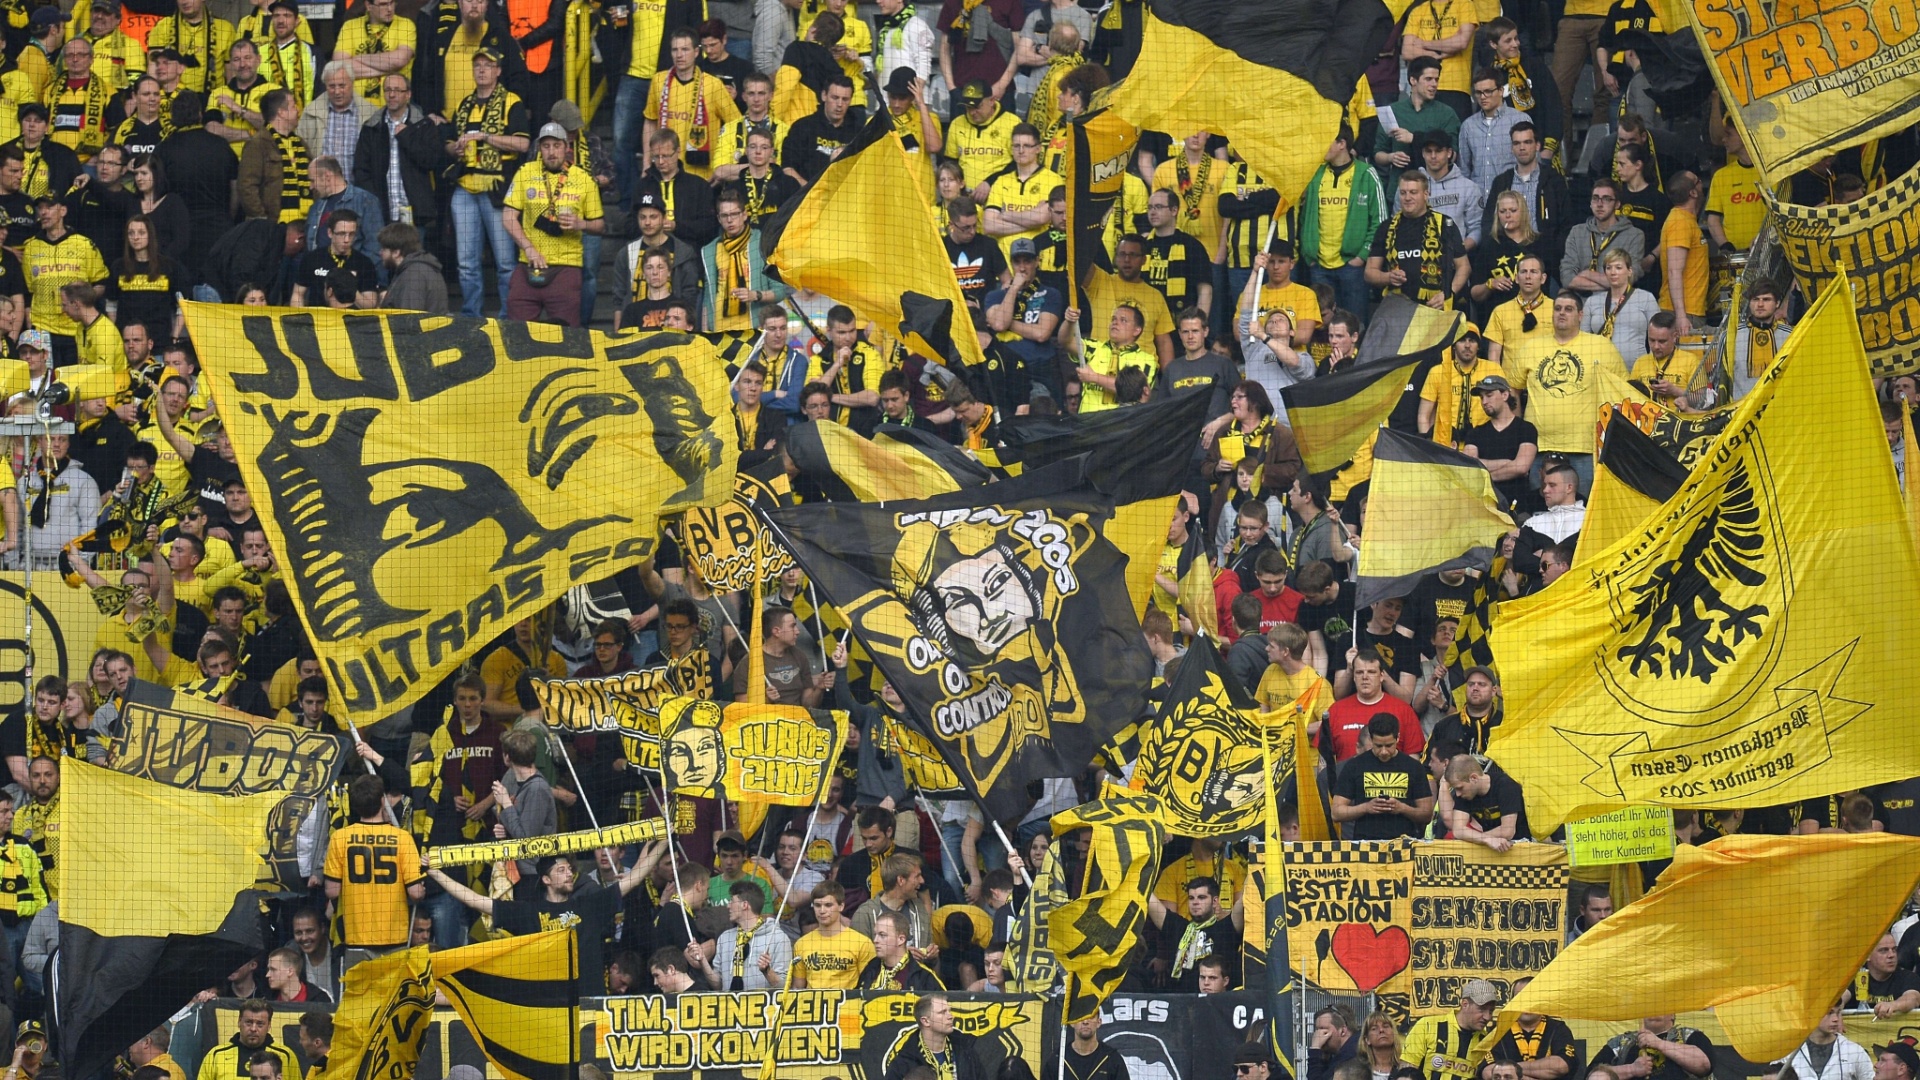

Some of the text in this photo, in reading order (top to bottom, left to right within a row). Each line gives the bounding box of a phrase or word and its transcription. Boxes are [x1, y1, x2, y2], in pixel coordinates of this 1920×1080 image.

[1714, 0, 1920, 107] VERBO
[1786, 80, 1818, 104] IHR
[1818, 60, 1869, 93] IMMER
[1841, 76, 1876, 98] WIR
[668, 111, 690, 121] EVO
[131, 144, 155, 153] EVO
[963, 146, 1004, 156] EVONIK
[537, 190, 581, 201] ENIK
[1320, 197, 1348, 206] EVON
[1784, 218, 1835, 244] Unity
[1785, 204, 1920, 273] EKTION
[40, 263, 81, 274] EVONIK
[1397, 249, 1421, 259] EVO
[1025, 310, 1040, 324] 87
[1858, 296, 1920, 350] BO
[689, 507, 755, 556] BVB
[1013, 505, 1078, 594] 2005
[326, 564, 546, 713] ULTRAS
[530, 667, 677, 731] BORUSSIA
[613, 699, 659, 736] VERB
[109, 704, 337, 795] JUBOS
[730, 719, 831, 760] JUBOS
[1629, 810, 1642, 821] Ihr
[1644, 807, 1669, 820] Wohl
[346, 833, 398, 846] JUBOS
[1575, 825, 1667, 843] steht höher, als das
[347, 846, 398, 885] 05
[1592, 843, 1656, 859] Ihrer Kunden!
[1251, 867, 1409, 904] ESTFALEN
[1288, 868, 1351, 879] FÜR IMMER
[1286, 900, 1392, 927] STADION
[1412, 896, 1561, 931] SEKTION
[810, 962, 848, 972] STADION
[1412, 938, 1560, 971] STADION
[1413, 976, 1518, 1009] VEB
[606, 989, 843, 1032] TIM, DEINE ZEIT
[890, 1001, 914, 1016] SE
[606, 1026, 838, 1068] WIRD KOMMEN!
